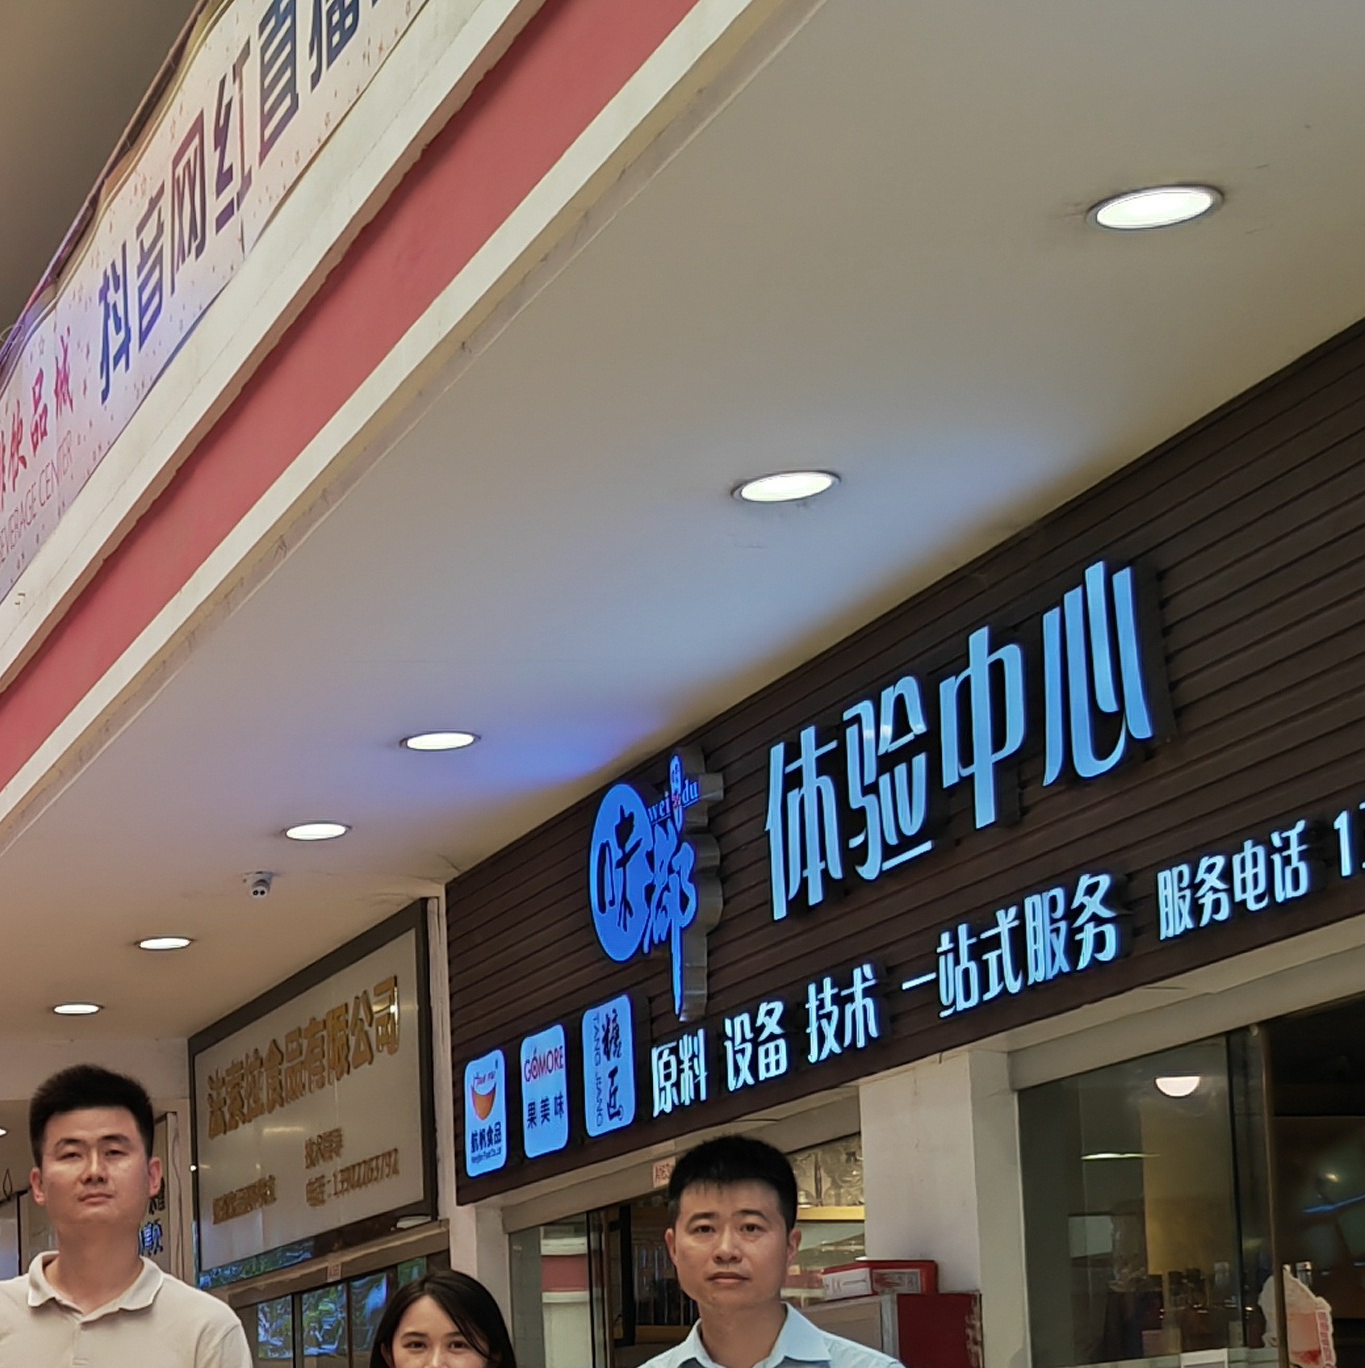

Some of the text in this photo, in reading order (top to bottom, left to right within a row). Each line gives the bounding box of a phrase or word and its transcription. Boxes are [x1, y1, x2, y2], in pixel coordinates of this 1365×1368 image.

[764, 560, 1154, 922] 体验中心
[1156, 818, 1310, 941] 服务电话
[651, 871, 1124, 1118] 原料 设备 技术 一站式服务
[526, 1091, 565, 1130] 果美味
